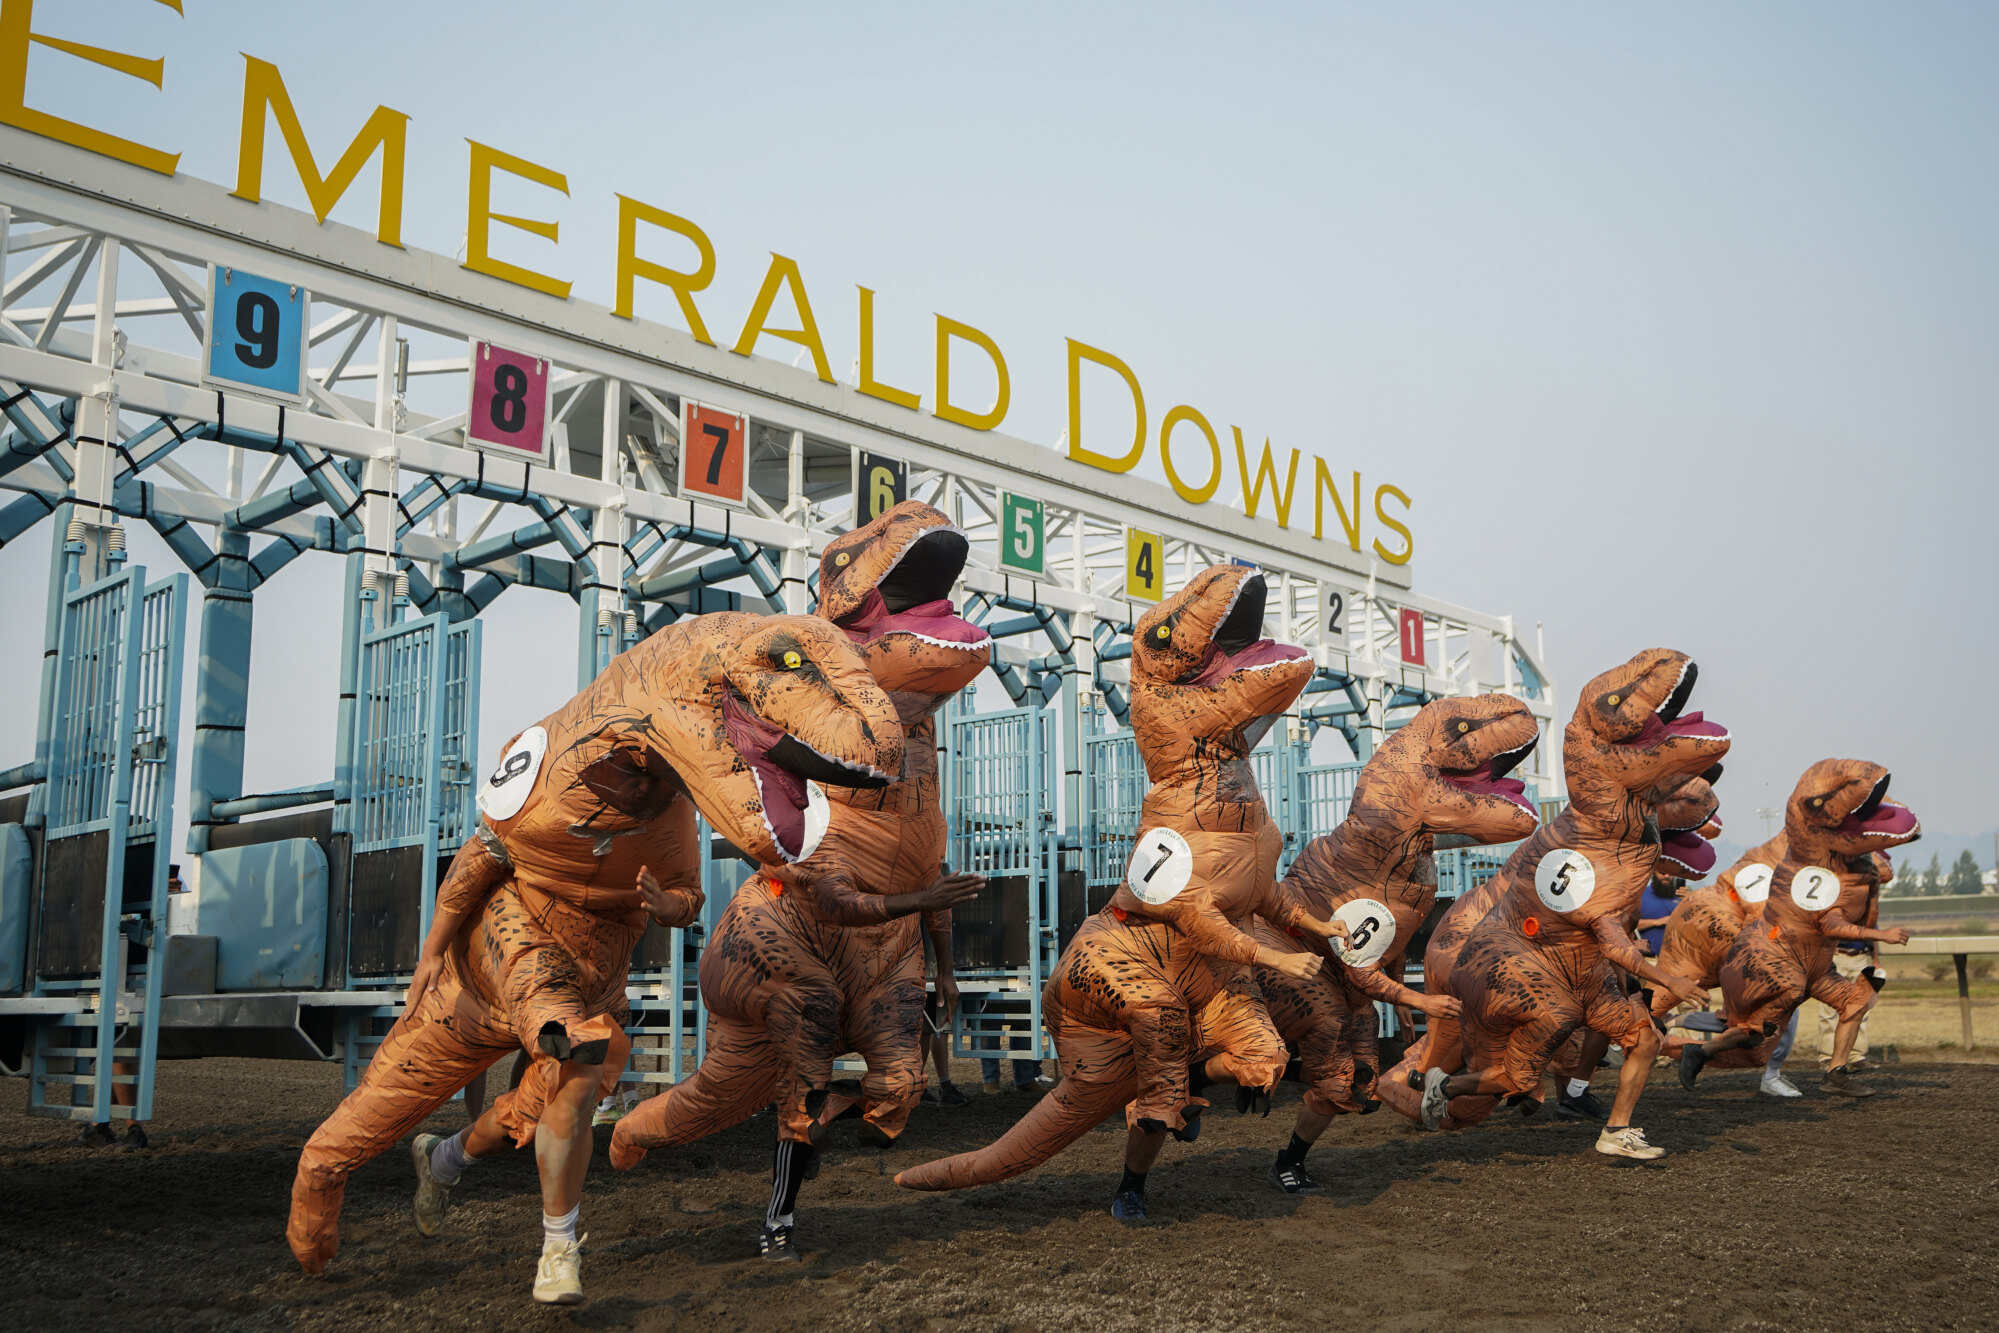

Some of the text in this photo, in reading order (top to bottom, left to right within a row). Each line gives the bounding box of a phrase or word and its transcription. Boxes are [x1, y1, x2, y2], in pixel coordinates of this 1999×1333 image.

[0, 0, 1413, 566] EMERALD DOWNS
[234, 291, 280, 369] 9
[490, 363, 528, 433] 8
[703, 422, 729, 486] 7
[869, 466, 896, 521] 6
[1014, 506, 1035, 560] 5
[1135, 542, 1154, 589] 4
[1328, 592, 1343, 635] 2
[1407, 618, 1416, 656] 1
[489, 750, 532, 788] 9
[1143, 843, 1174, 884] 7
[1550, 862, 1578, 896] 5
[1805, 875, 1823, 901] 2
[1352, 916, 1380, 950] 6
